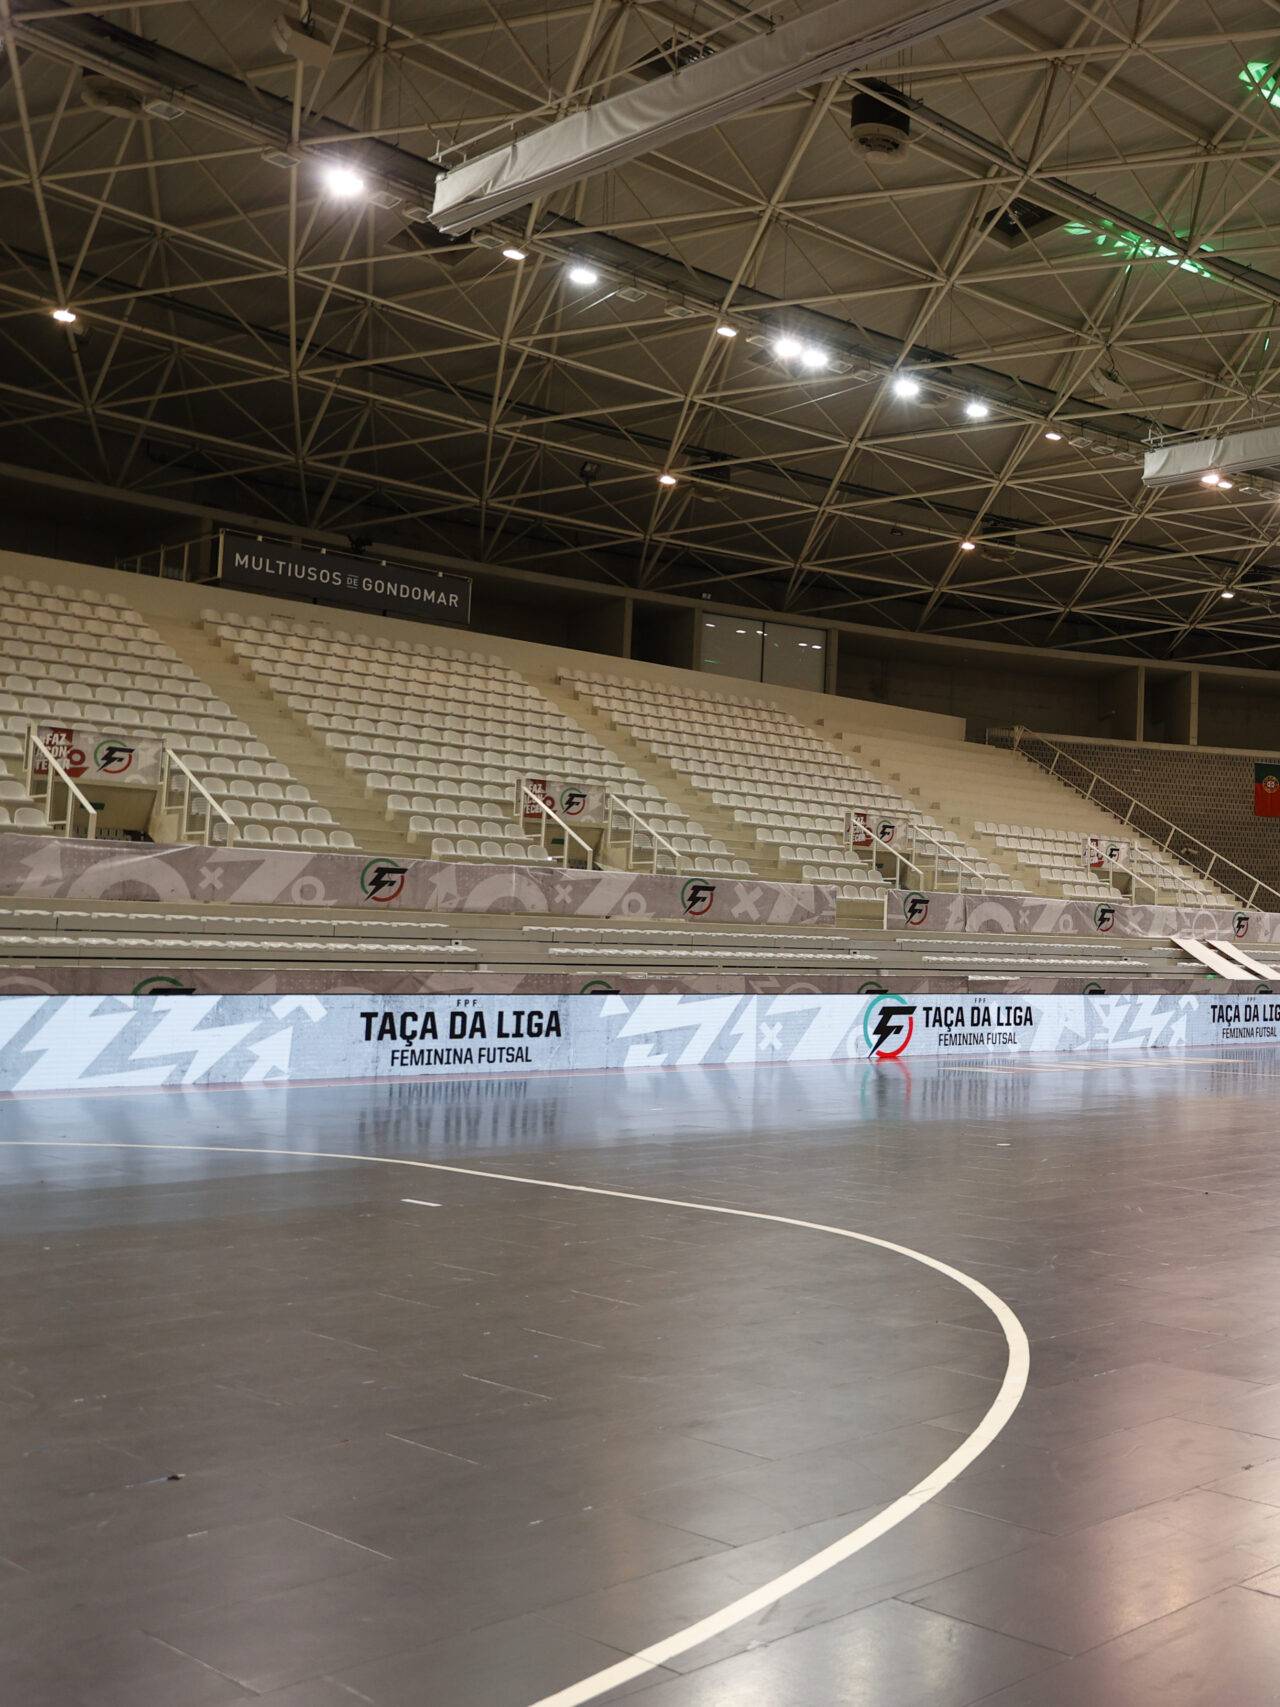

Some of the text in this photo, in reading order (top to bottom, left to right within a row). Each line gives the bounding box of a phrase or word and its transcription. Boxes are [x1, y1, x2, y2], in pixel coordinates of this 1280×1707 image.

[234, 552, 459, 608] MULTIUSOS DE GONDOMAR
[456, 999, 478, 1007] FPF
[923, 1006, 1034, 1032] TAÇA DA LIGA
[1210, 1004, 1240, 1027] TAÇA
[1244, 1004, 1260, 1022] DA
[360, 1010, 562, 1047] TAÇA DA LIGA
[938, 1032, 1018, 1046] FEMININA FUTSAL
[1222, 1026, 1277, 1038] FEMININA FUTSAL
[390, 1046, 532, 1067] FEMININA FUTSAL
